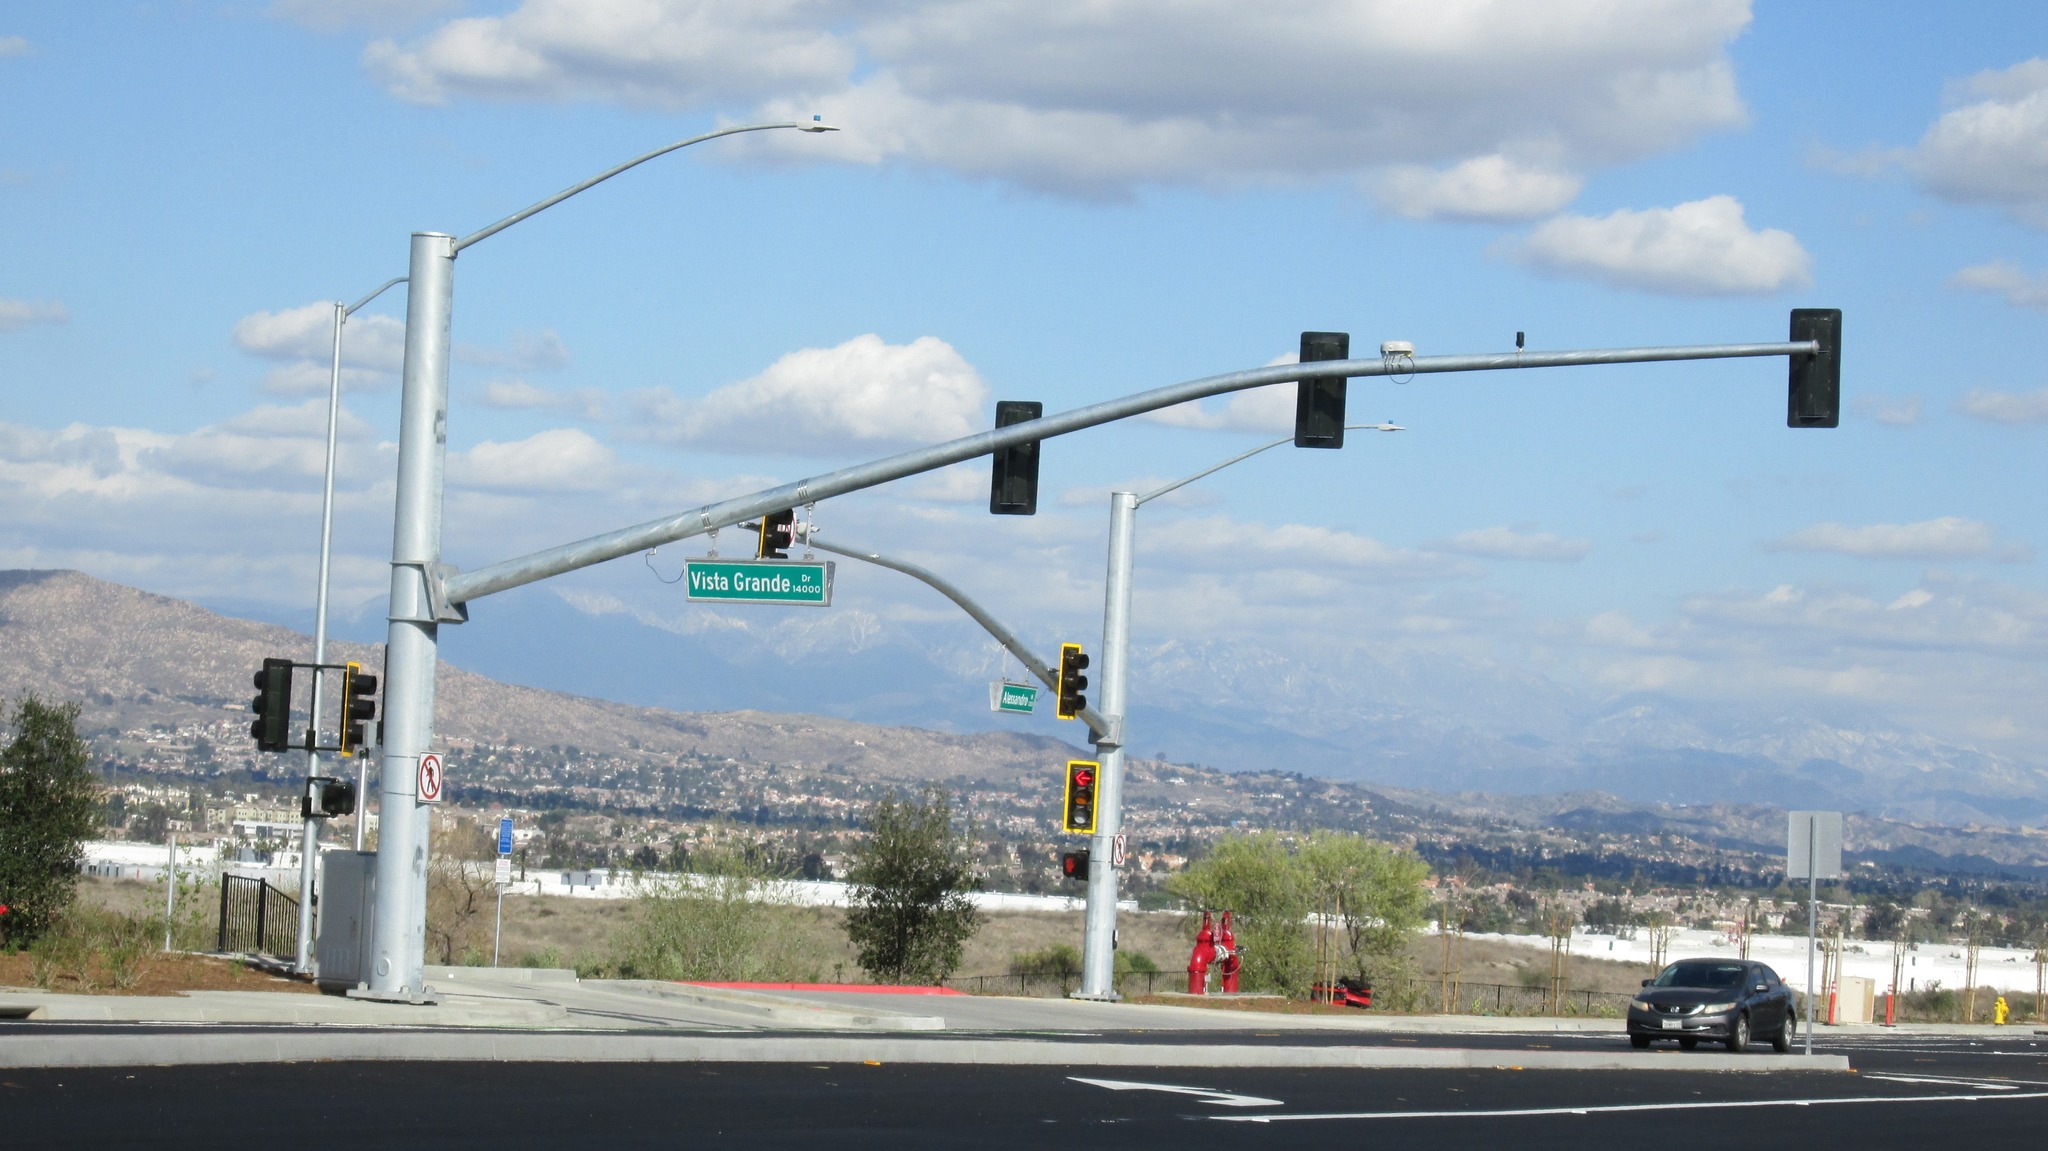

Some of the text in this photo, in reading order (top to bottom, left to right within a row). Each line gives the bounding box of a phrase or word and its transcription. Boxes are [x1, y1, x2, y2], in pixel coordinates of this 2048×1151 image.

[691, 571, 811, 593] Vista Grande Dr
[792, 584, 821, 594] 14000
[1002, 691, 1029, 706] Alessandro
